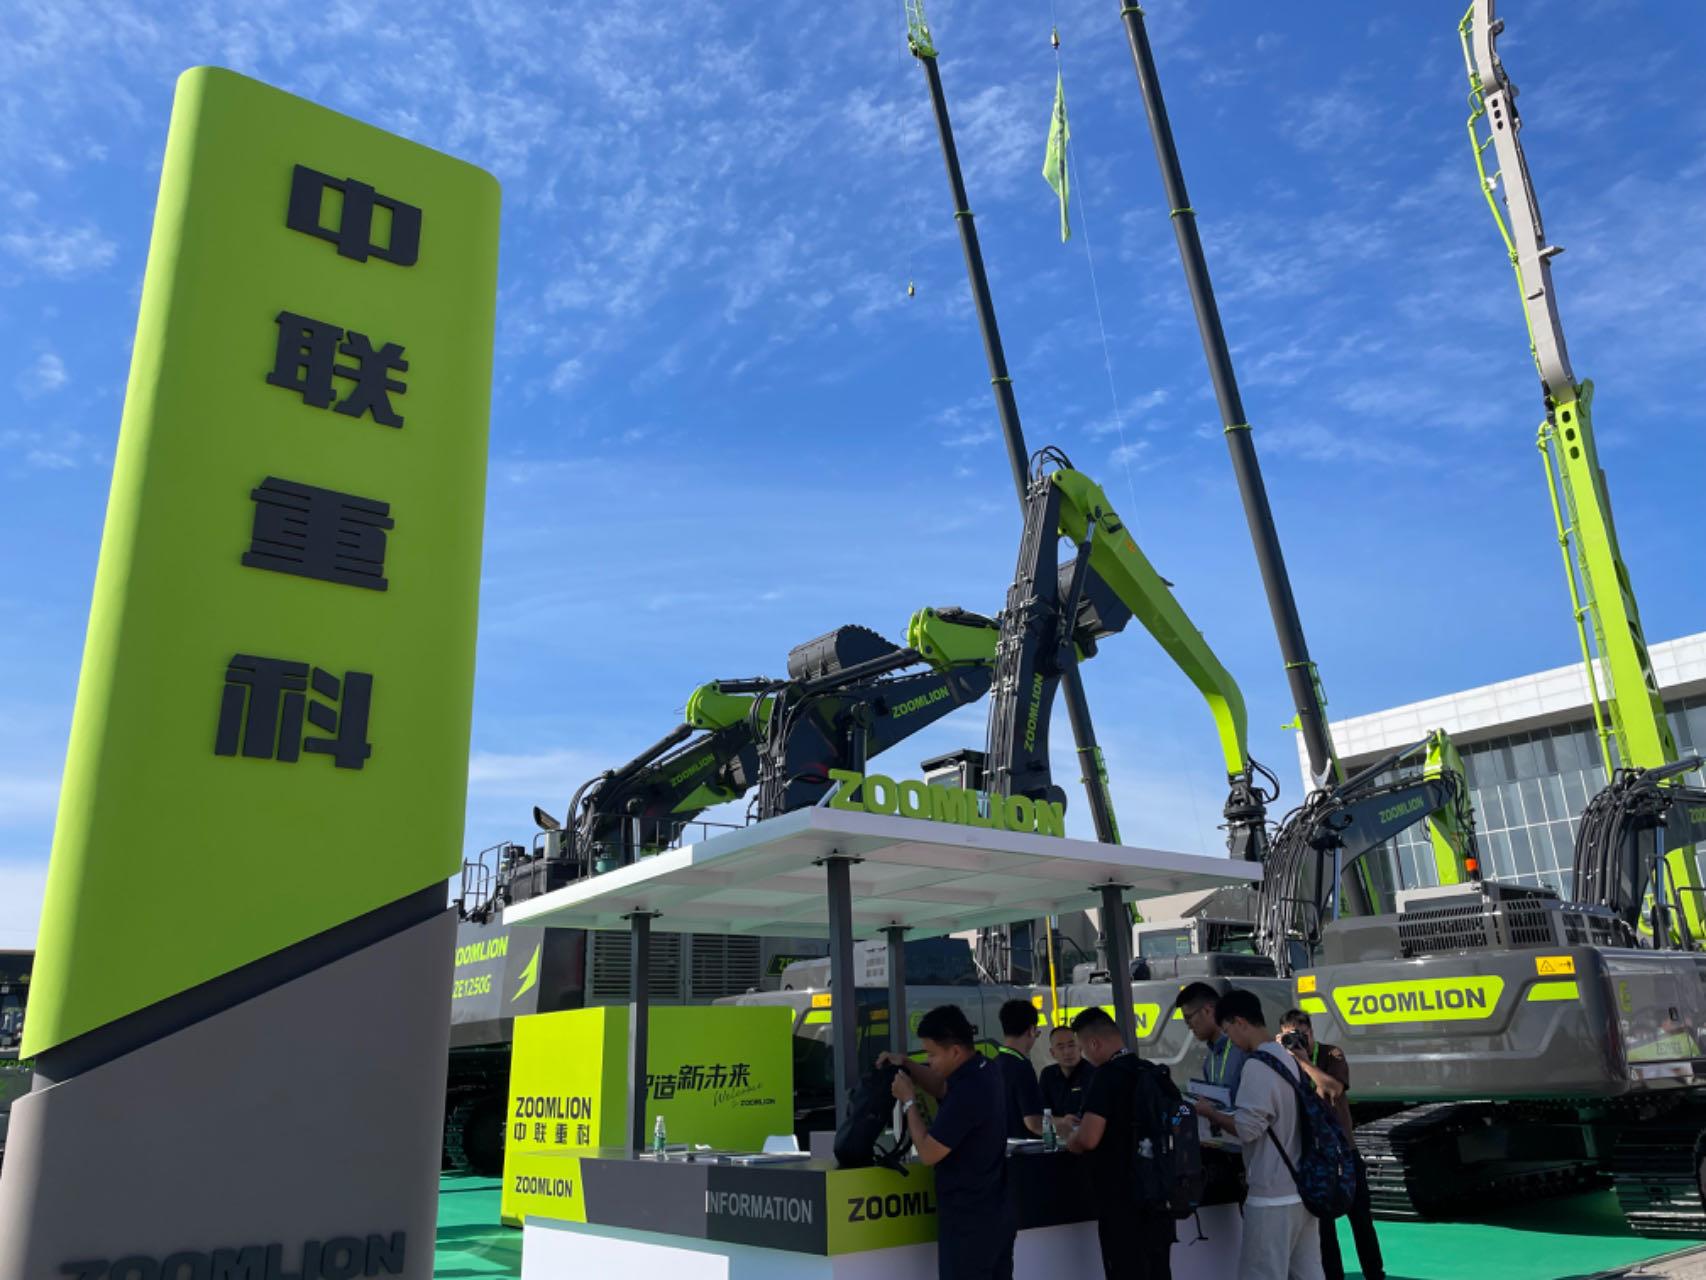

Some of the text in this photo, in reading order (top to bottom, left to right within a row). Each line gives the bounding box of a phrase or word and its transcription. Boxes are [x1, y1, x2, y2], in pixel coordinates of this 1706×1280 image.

[214, 163, 422, 770] 中联重科
[891, 686, 949, 719] ZOOMLION
[1024, 672, 1044, 753] ZOOMLION
[828, 768, 1066, 838] ZOOMLION
[454, 935, 509, 967] OOMLION
[1347, 987, 1487, 1016] ZOOMLION
[515, 1096, 592, 1120] ZOOMLION
[514, 1121, 591, 1147] 中联重科
[515, 1176, 573, 1198] ZOOMLION
[705, 1189, 813, 1225] INFORMATION
